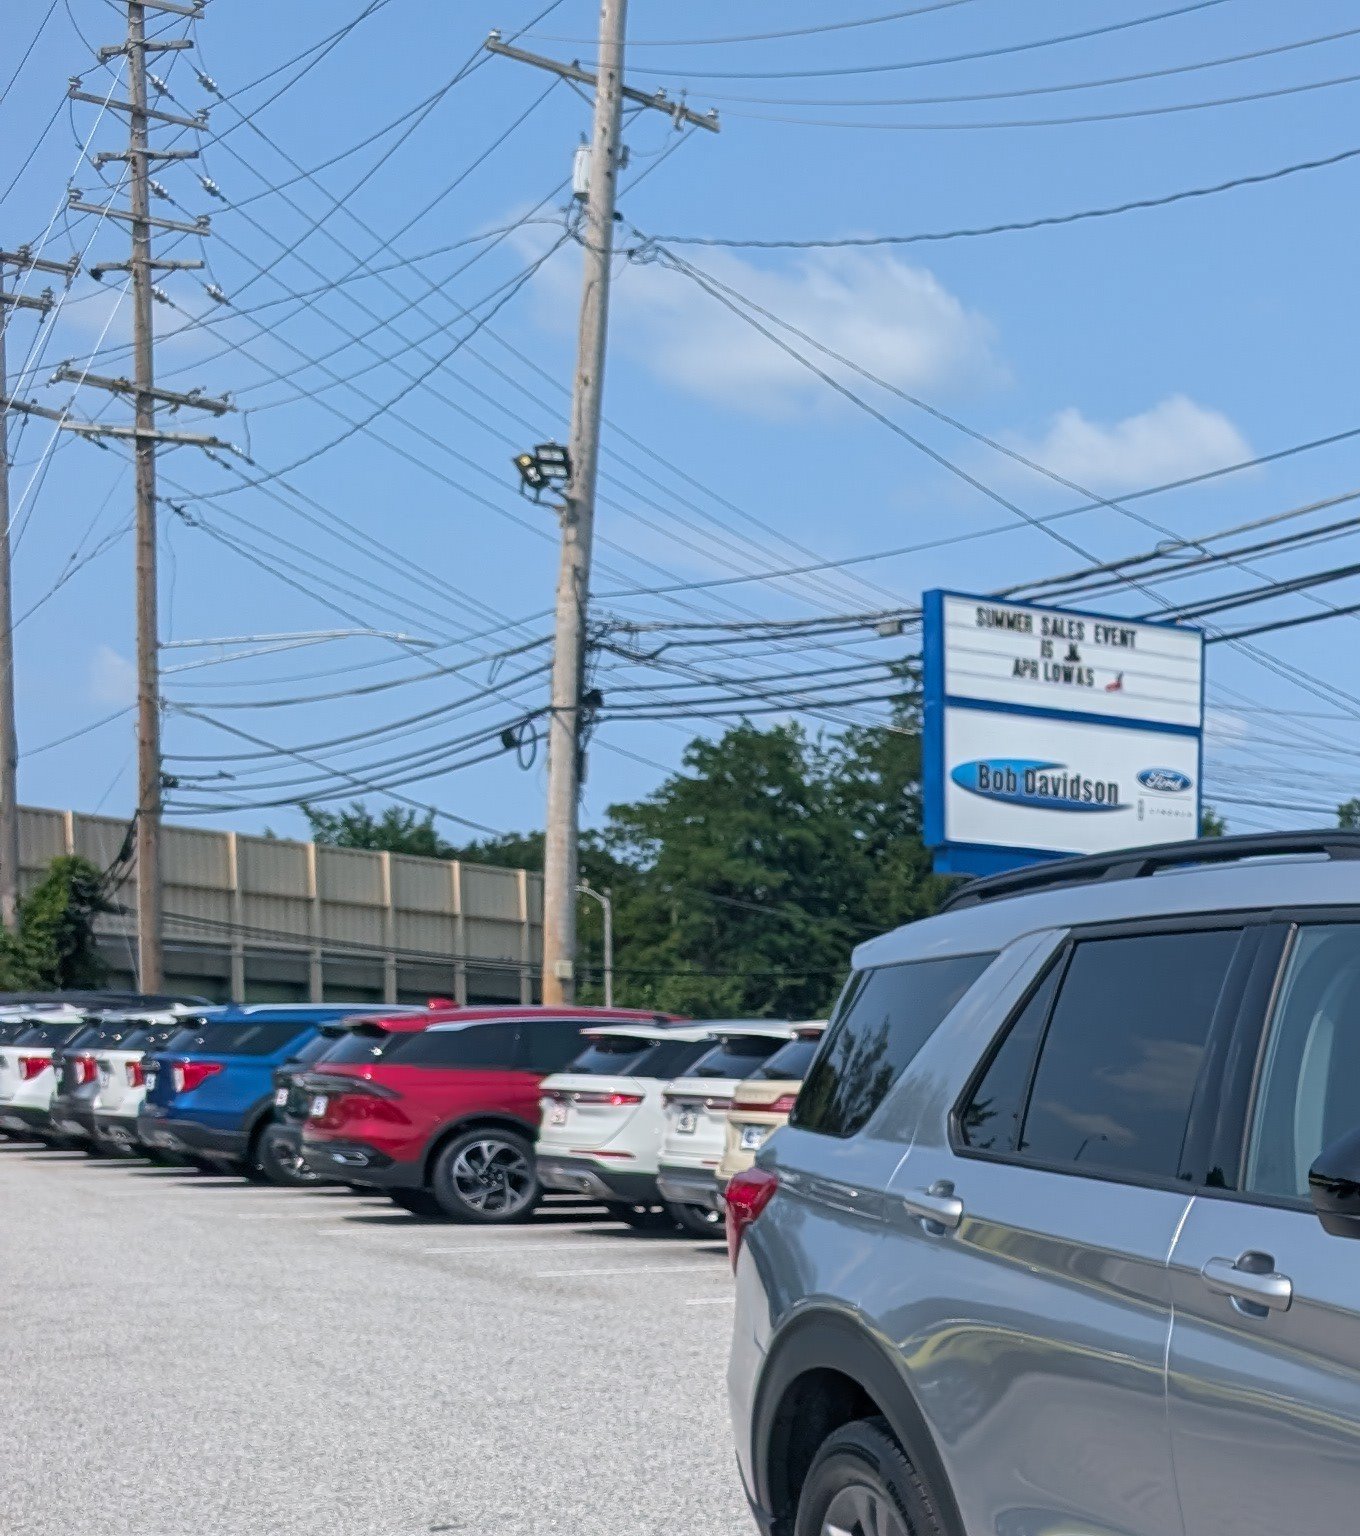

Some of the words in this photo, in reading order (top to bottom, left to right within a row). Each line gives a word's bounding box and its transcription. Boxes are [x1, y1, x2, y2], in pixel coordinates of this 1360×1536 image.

[976, 606, 1033, 633] SUMMER
[1041, 615, 1085, 641] SALES
[1094, 623, 1138, 648] EVENT
[1041, 638, 1054, 659] IS
[1013, 657, 1039, 681] APR
[978, 764, 1017, 792] Bob
[1024, 768, 1119, 805] Davidson
[1146, 771, 1185, 790] Ford
